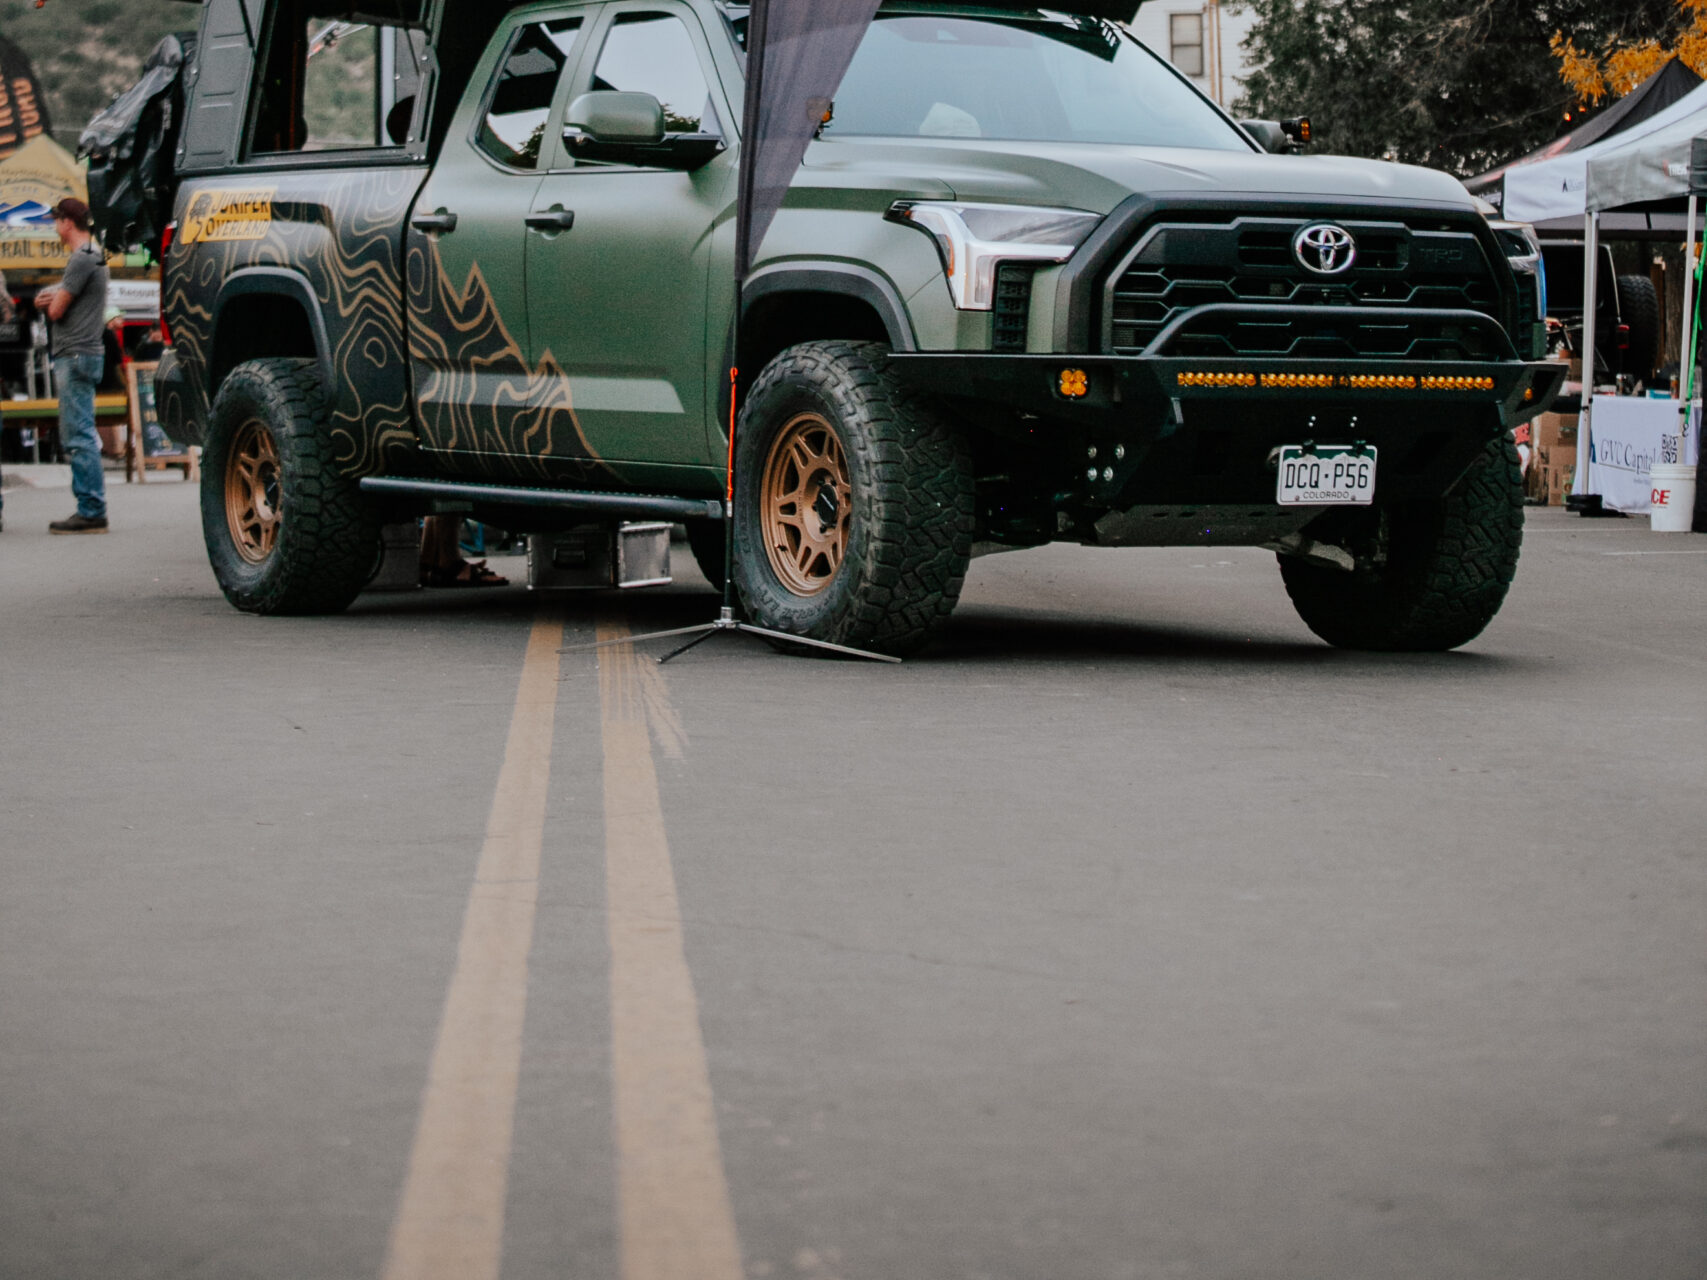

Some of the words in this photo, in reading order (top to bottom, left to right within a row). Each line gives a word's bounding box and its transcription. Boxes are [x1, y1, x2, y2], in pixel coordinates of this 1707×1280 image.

[211, 191, 271, 214] JUNIPER
[205, 218, 269, 237] OVERLAND
[1, 239, 34, 258] RAIL
[1600, 438, 1623, 465] GVC
[1303, 491, 1349, 499] COLORADO
[1650, 488, 1671, 505] CE
